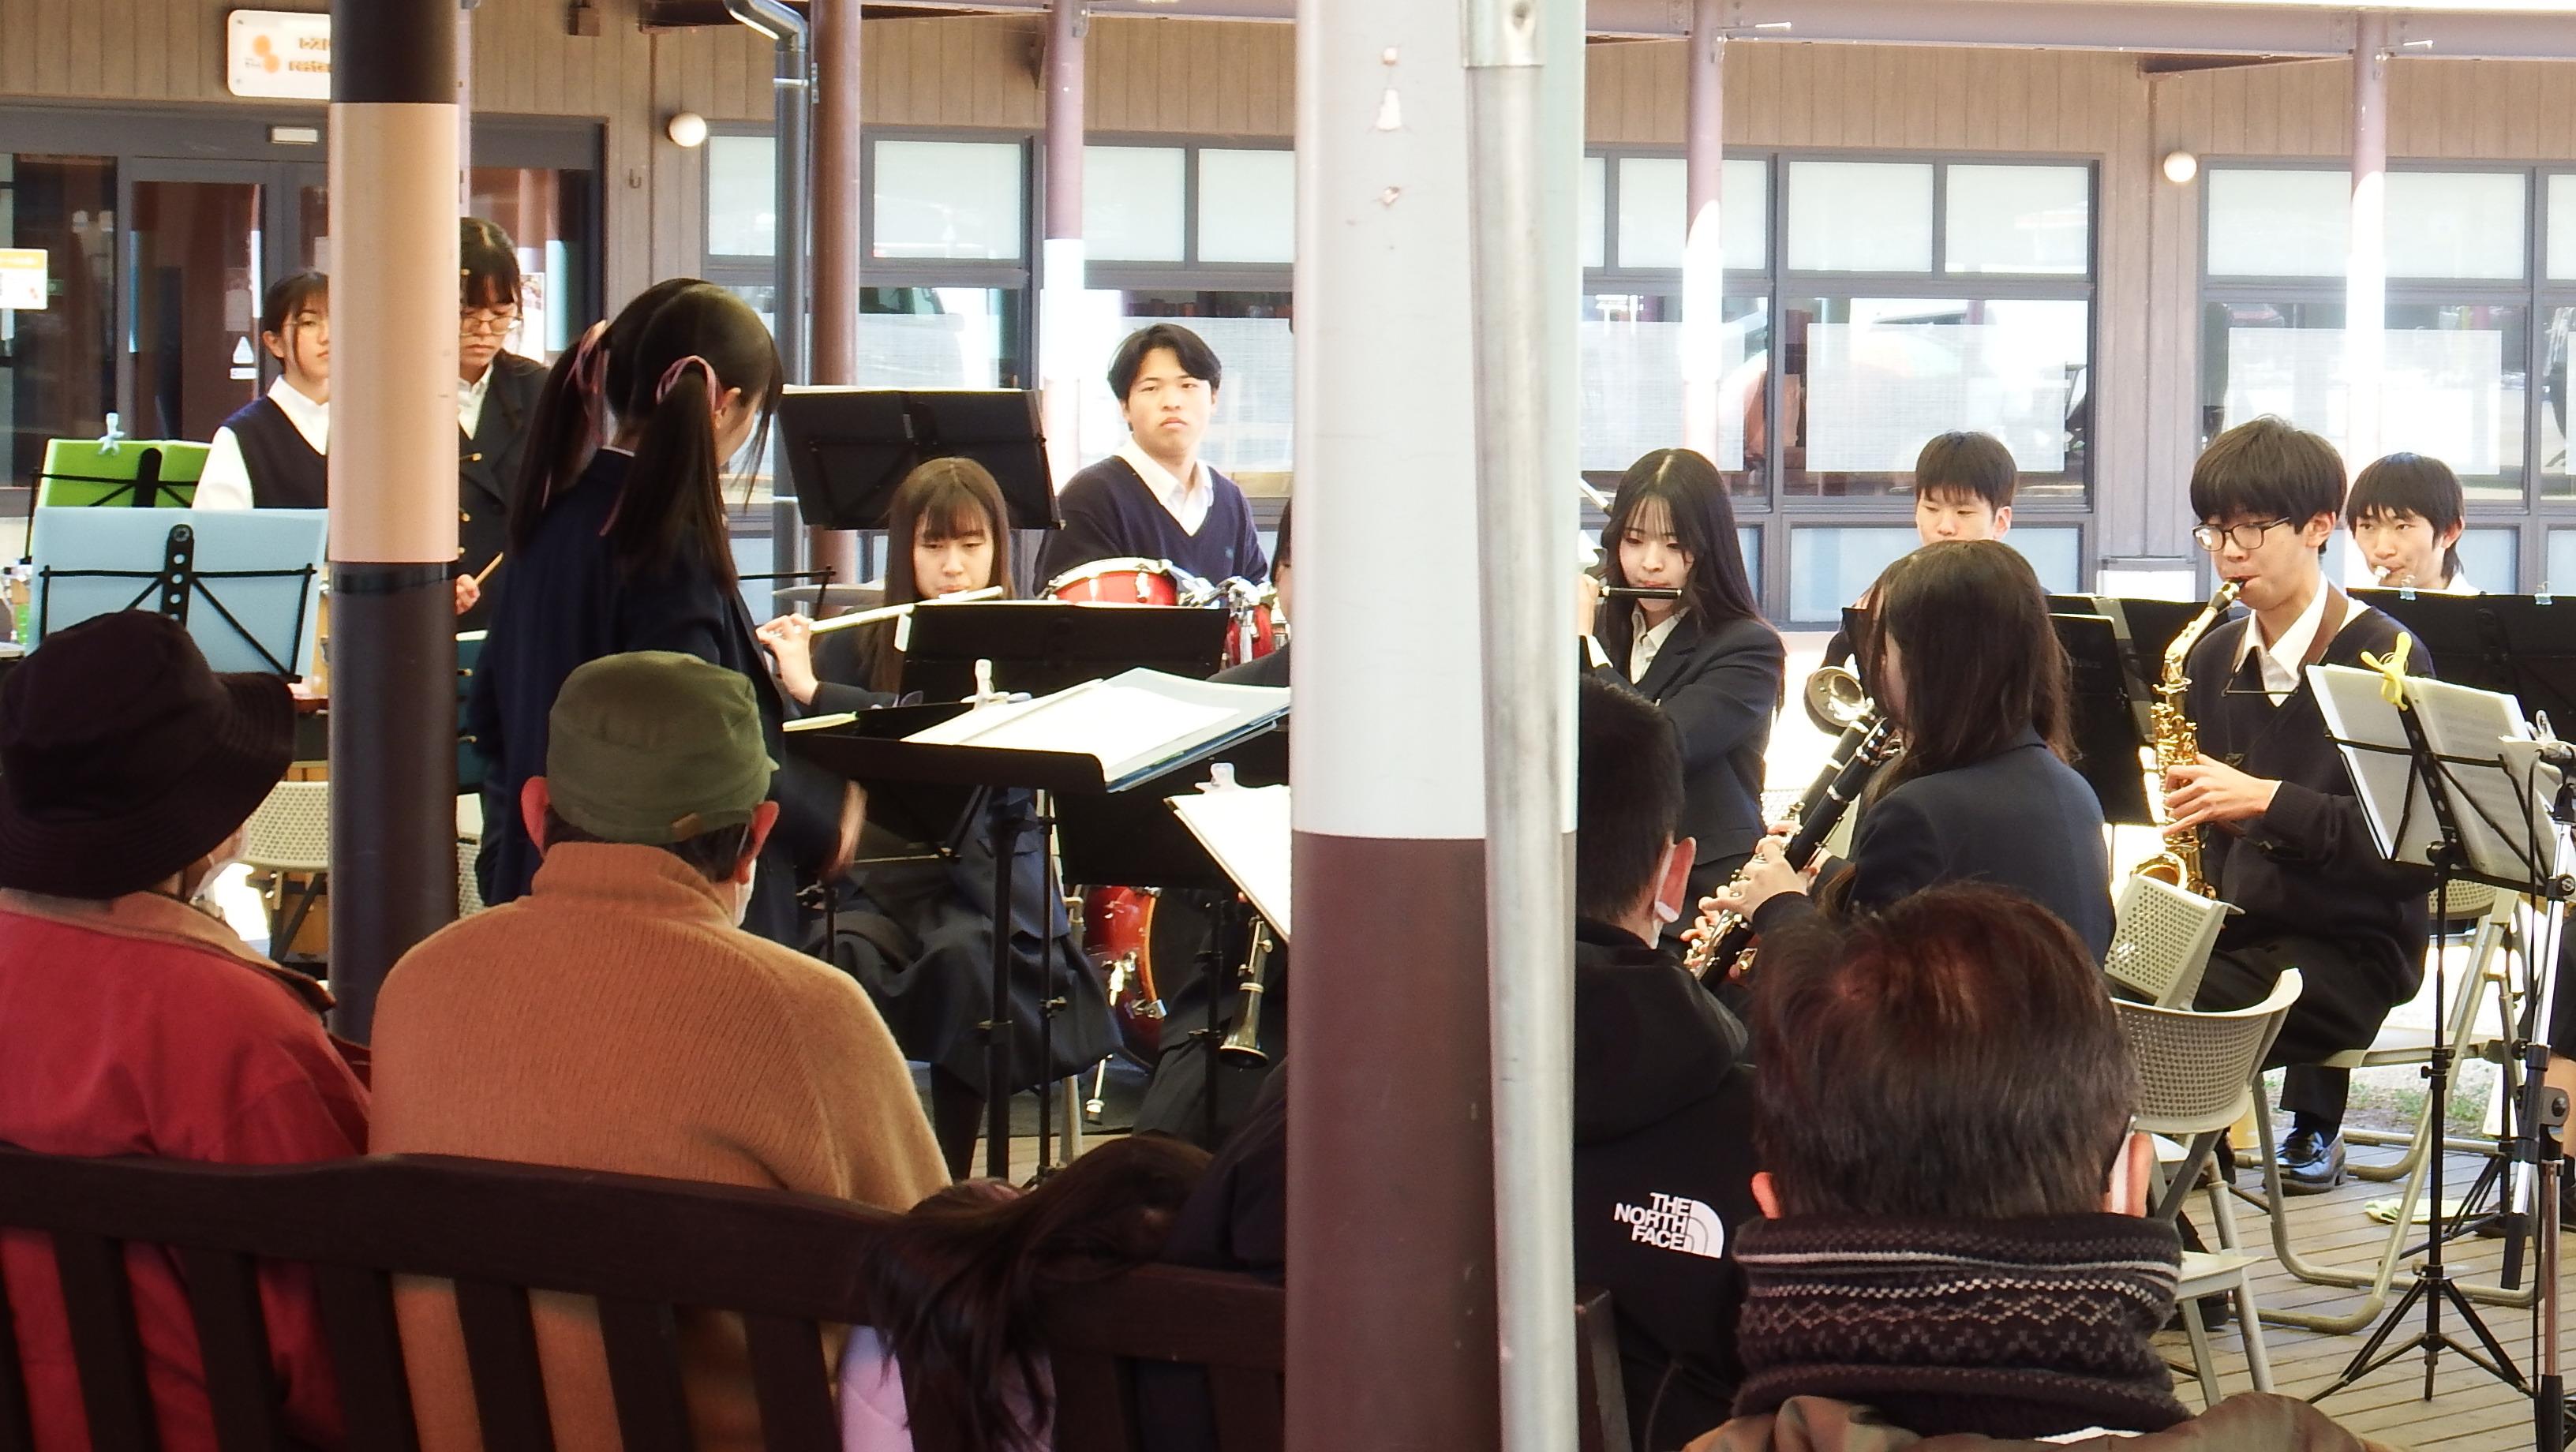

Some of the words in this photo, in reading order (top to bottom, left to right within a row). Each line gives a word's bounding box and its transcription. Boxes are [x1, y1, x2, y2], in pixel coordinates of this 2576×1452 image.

[1649, 1192, 1692, 1216] THE
[1614, 1203, 1687, 1234] NORTH
[1631, 1225, 1685, 1251] FACE
